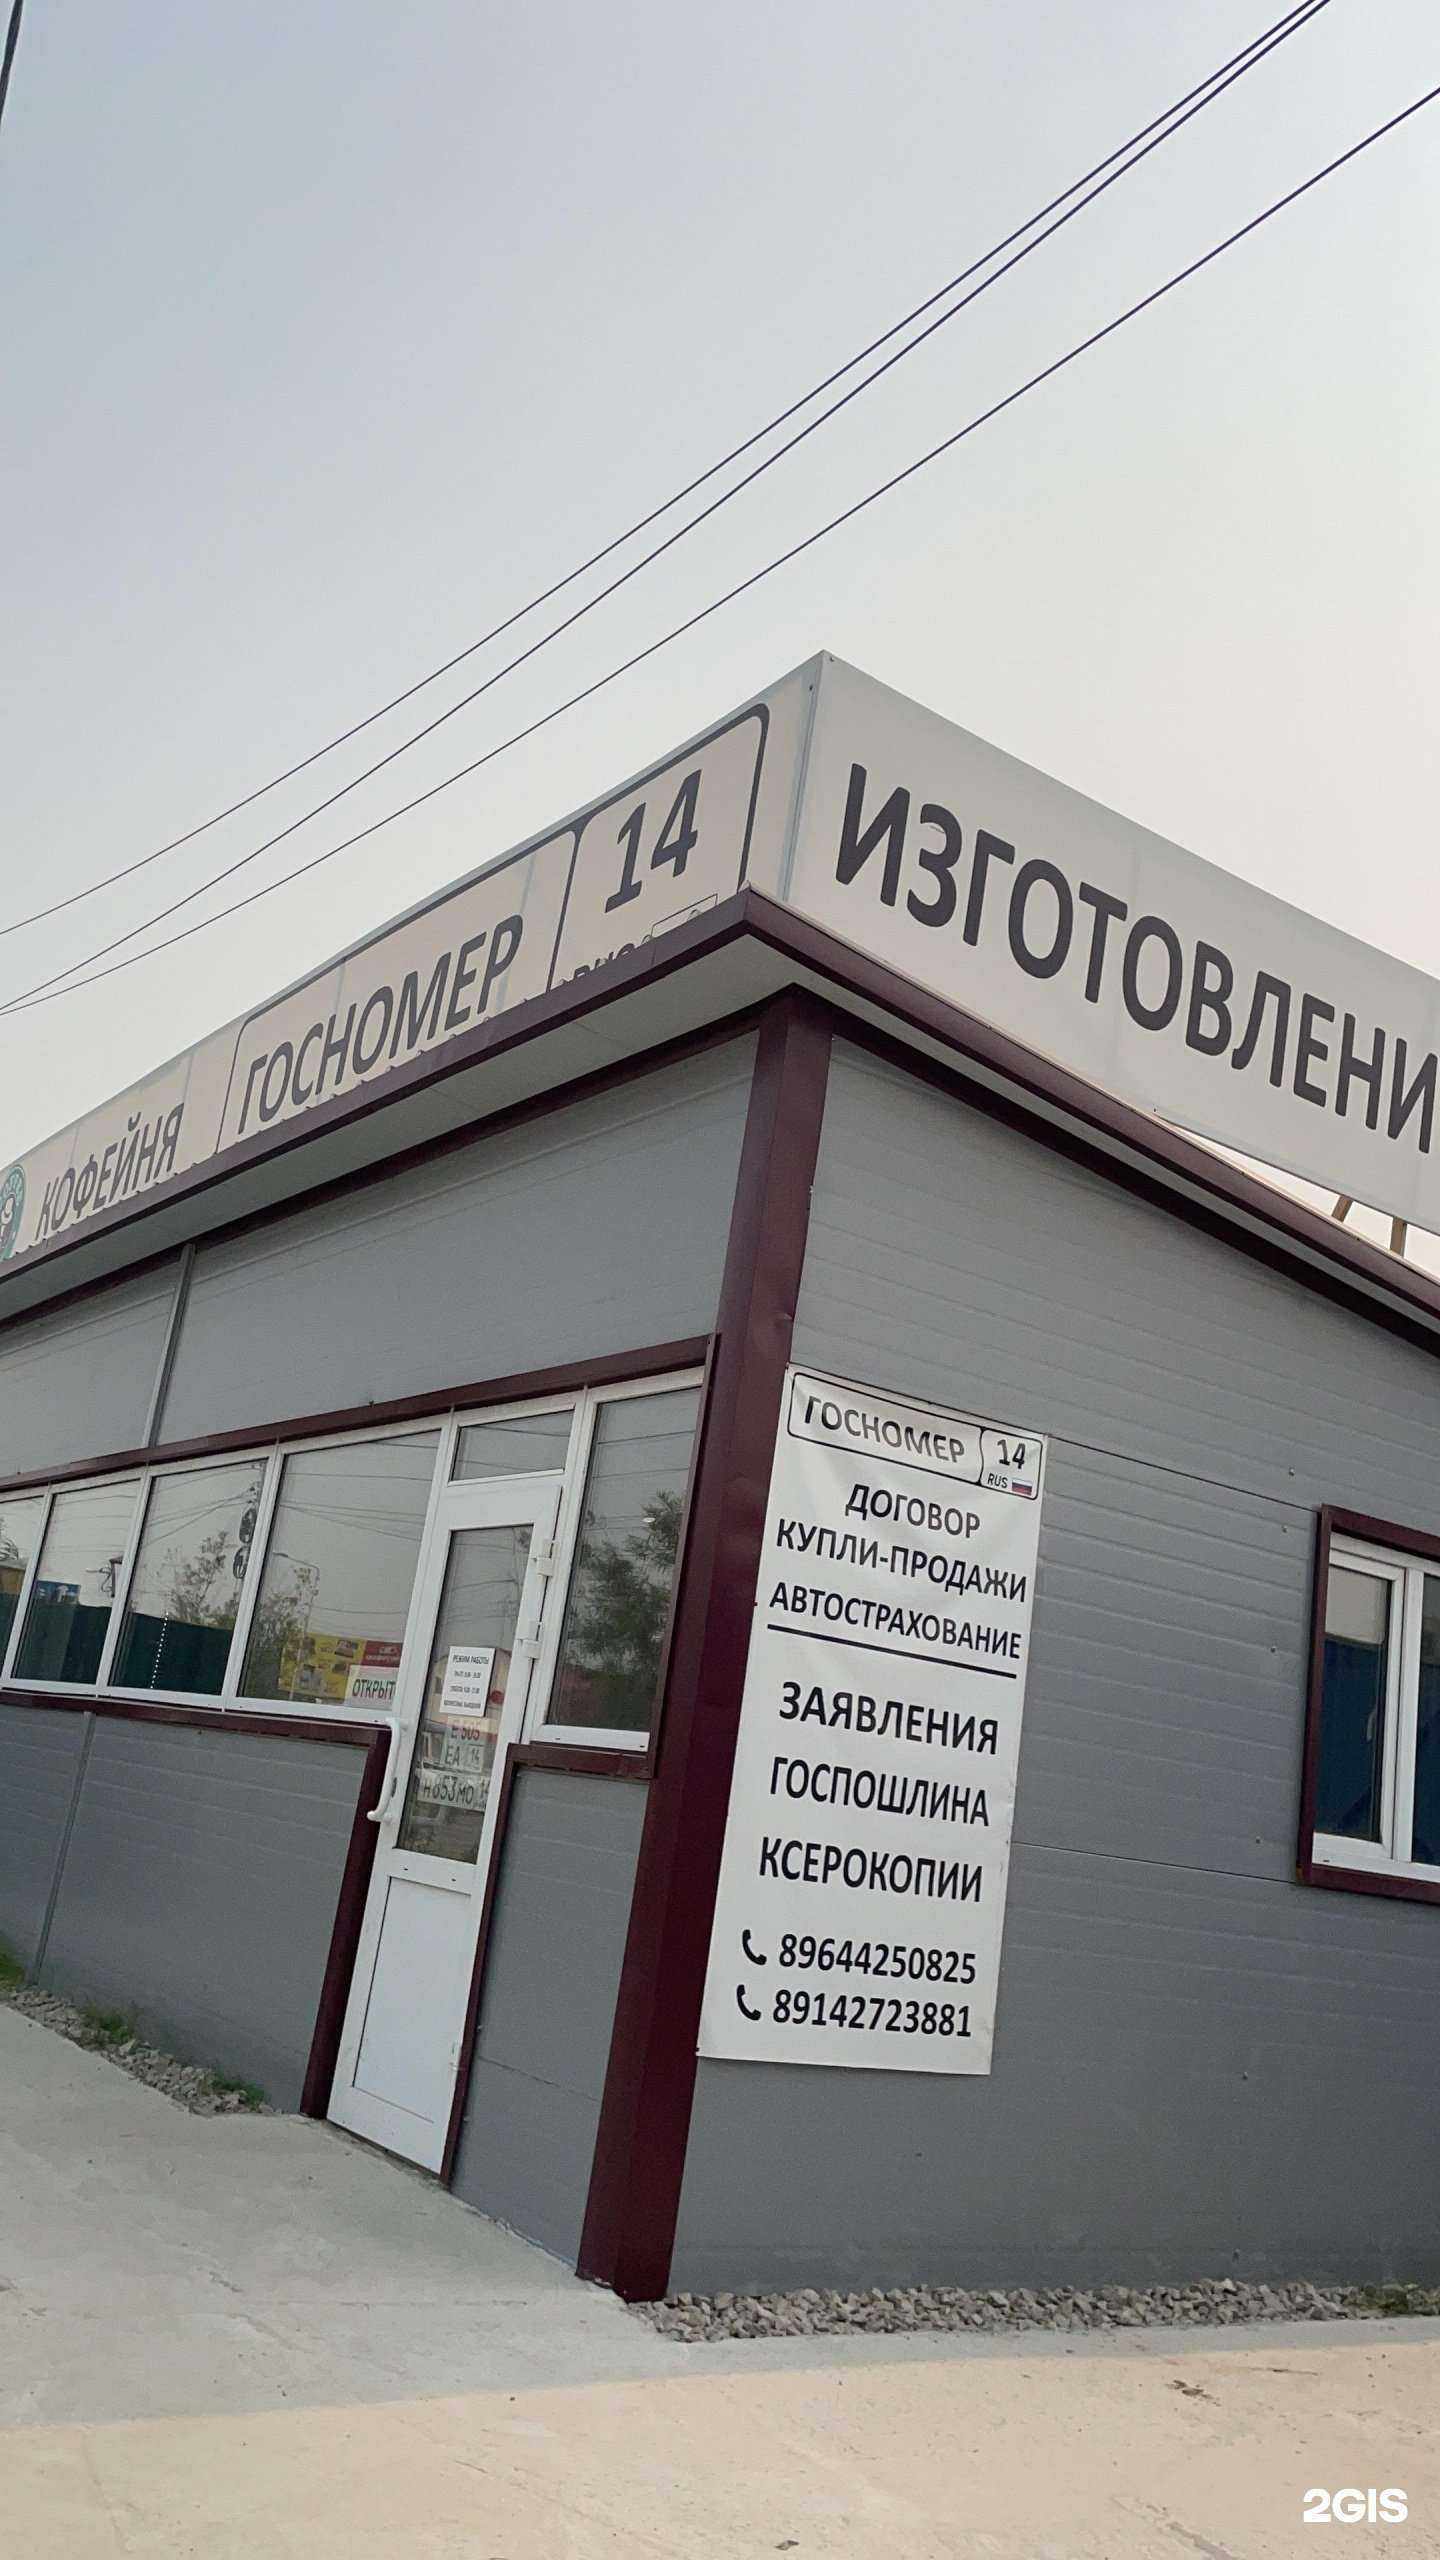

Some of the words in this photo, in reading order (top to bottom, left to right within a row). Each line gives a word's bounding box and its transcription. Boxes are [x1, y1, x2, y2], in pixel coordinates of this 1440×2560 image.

[238, 915, 523, 1134] ГОСНОМЕР
[605, 769, 702, 913] 14
[836, 763, 1438, 1153] ИЗГОТОВЛЕНИ
[35, 1103, 184, 1240] КОФЕЙНЯ
[804, 1396, 965, 1463] ГОСНОМЕР
[997, 1439, 1026, 1469] 14
[845, 1484, 980, 1538] ДОГОВОР
[987, 1472, 1009, 1489] RUS
[776, 1519, 1027, 1602] КУПЛИ-ПРОДАЖИ
[769, 1582, 1021, 1659] АВТОСТРАХОВАНИЕ
[779, 1681, 998, 1755] ЗАЯВЛЕНИЯ
[770, 1756, 989, 1827] ГОСПОШЛИНА
[759, 1836, 982, 1902] КСЕРОКОПИИ
[779, 1933, 976, 1984] 89644250825
[772, 1989, 971, 2037] 89142723881
